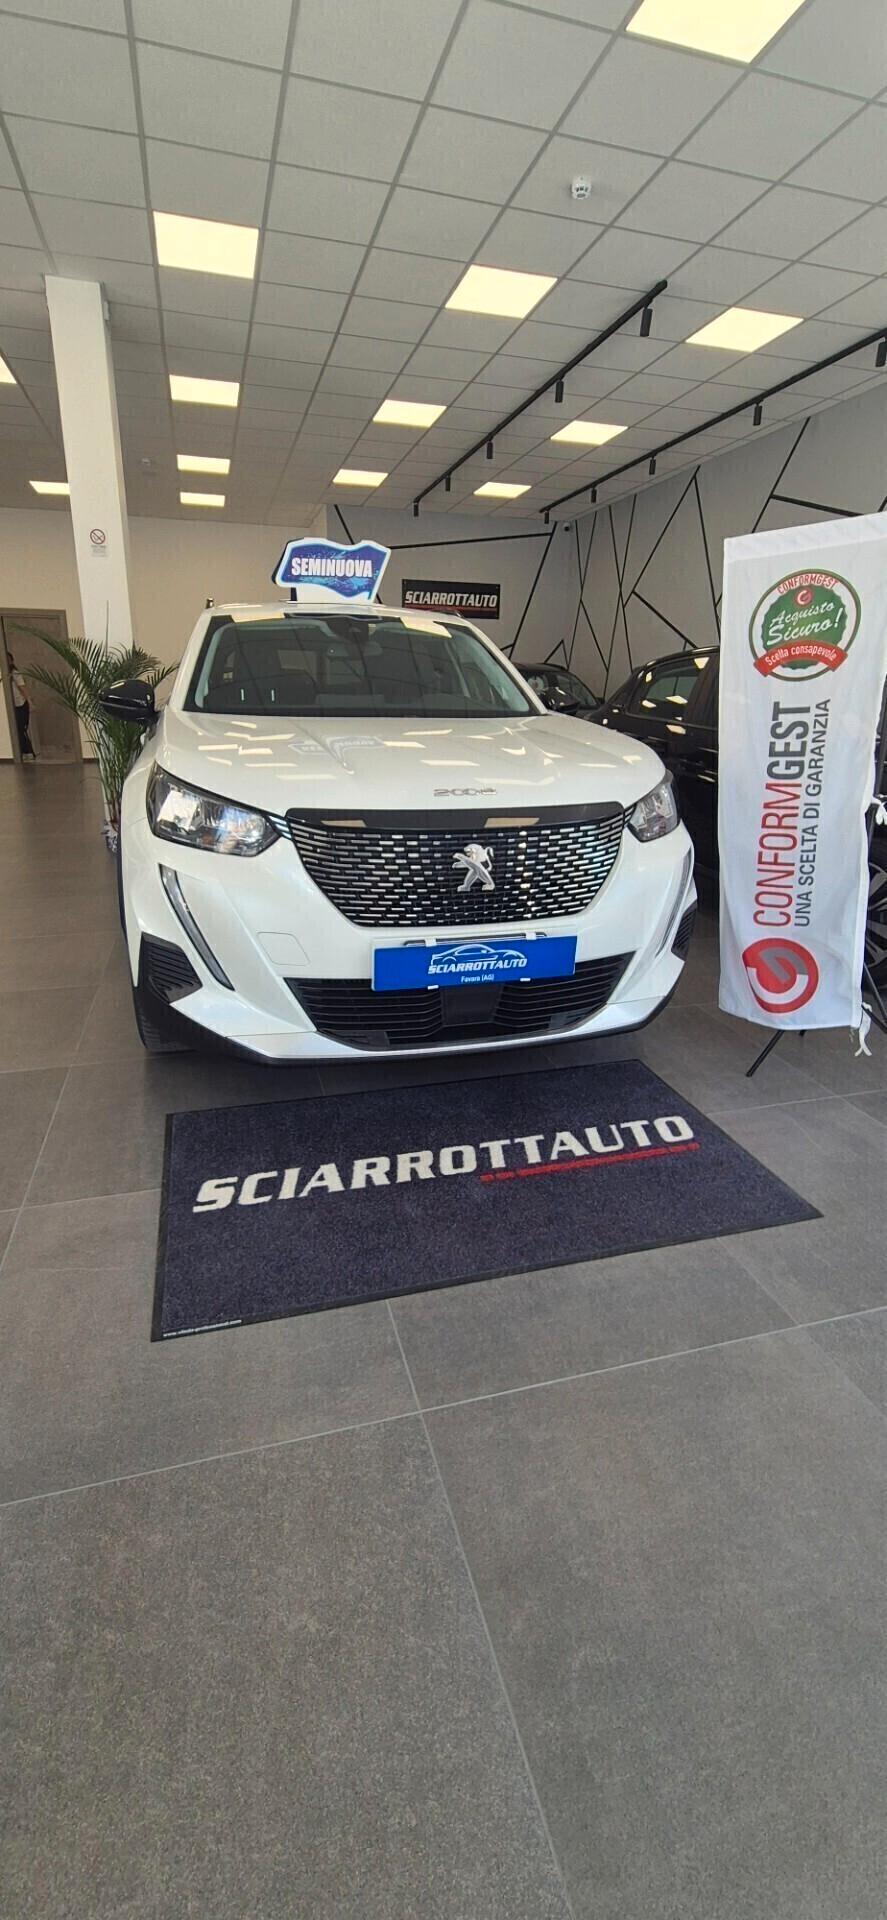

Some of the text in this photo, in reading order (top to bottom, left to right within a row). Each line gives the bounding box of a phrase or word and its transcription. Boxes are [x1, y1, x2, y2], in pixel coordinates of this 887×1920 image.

[291, 556, 373, 578] SEMINUOVA
[777, 573, 839, 595] CONFORMGEST
[404, 590, 498, 608] SCIARROTTAUTO
[769, 601, 835, 627] Acquisto
[766, 607, 844, 646] Sicuro!
[790, 645, 837, 661] consapevole
[753, 700, 811, 927] CONFORMGEST
[794, 698, 831, 927] UNA SCELTA DI GARANZIA
[427, 958, 528, 974] SCIARROTTAUTO
[193, 1115, 694, 1213] SCIARROTTAUTO
